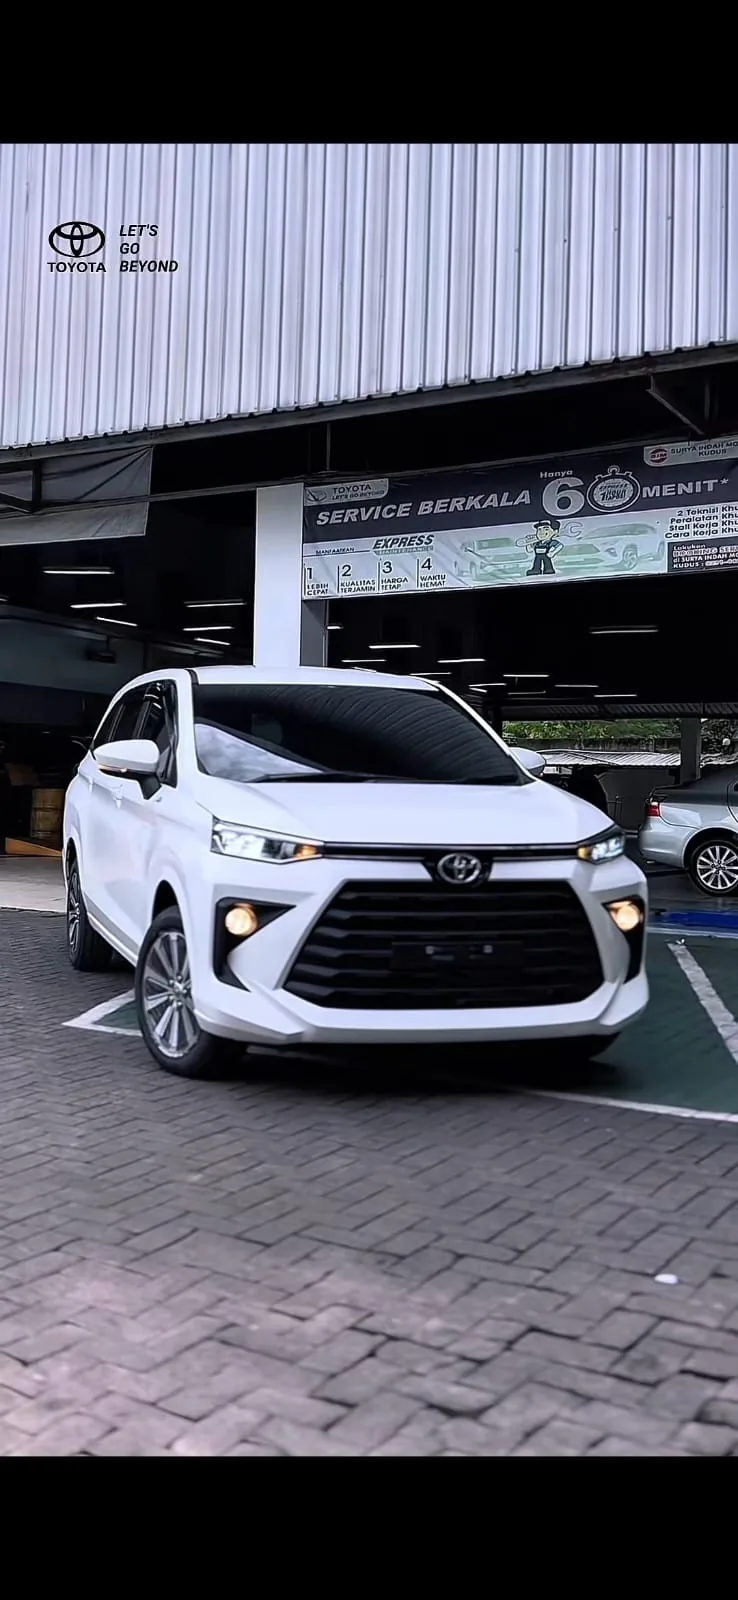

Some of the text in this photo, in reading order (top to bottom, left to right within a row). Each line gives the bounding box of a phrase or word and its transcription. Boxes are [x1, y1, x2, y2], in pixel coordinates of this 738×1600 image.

[670, 446, 697, 454] SURYA
[698, 441, 724, 451] INDAH
[698, 448, 727, 457] KUDUS
[540, 469, 573, 480] Hanya
[332, 484, 372, 494] TOYOTA
[316, 502, 413, 526] SERVICE
[417, 490, 531, 516] BERKALA
[686, 506, 719, 516] Teknisi
[670, 514, 719, 525] Peralatan
[669, 524, 690, 532] Stall
[693, 521, 719, 531] Kerja
[664, 530, 690, 539] Cara
[693, 528, 719, 538] Kerja
[372, 534, 435, 550] EXPRESS
[382, 561, 393, 574] 3
[421, 557, 433, 570] 4
[306, 567, 313, 580] 1
[341, 564, 352, 577] 2
[381, 577, 409, 585] HARGA
[420, 574, 446, 582] WAKTU
[340, 585, 376, 593] TERJAMIN
